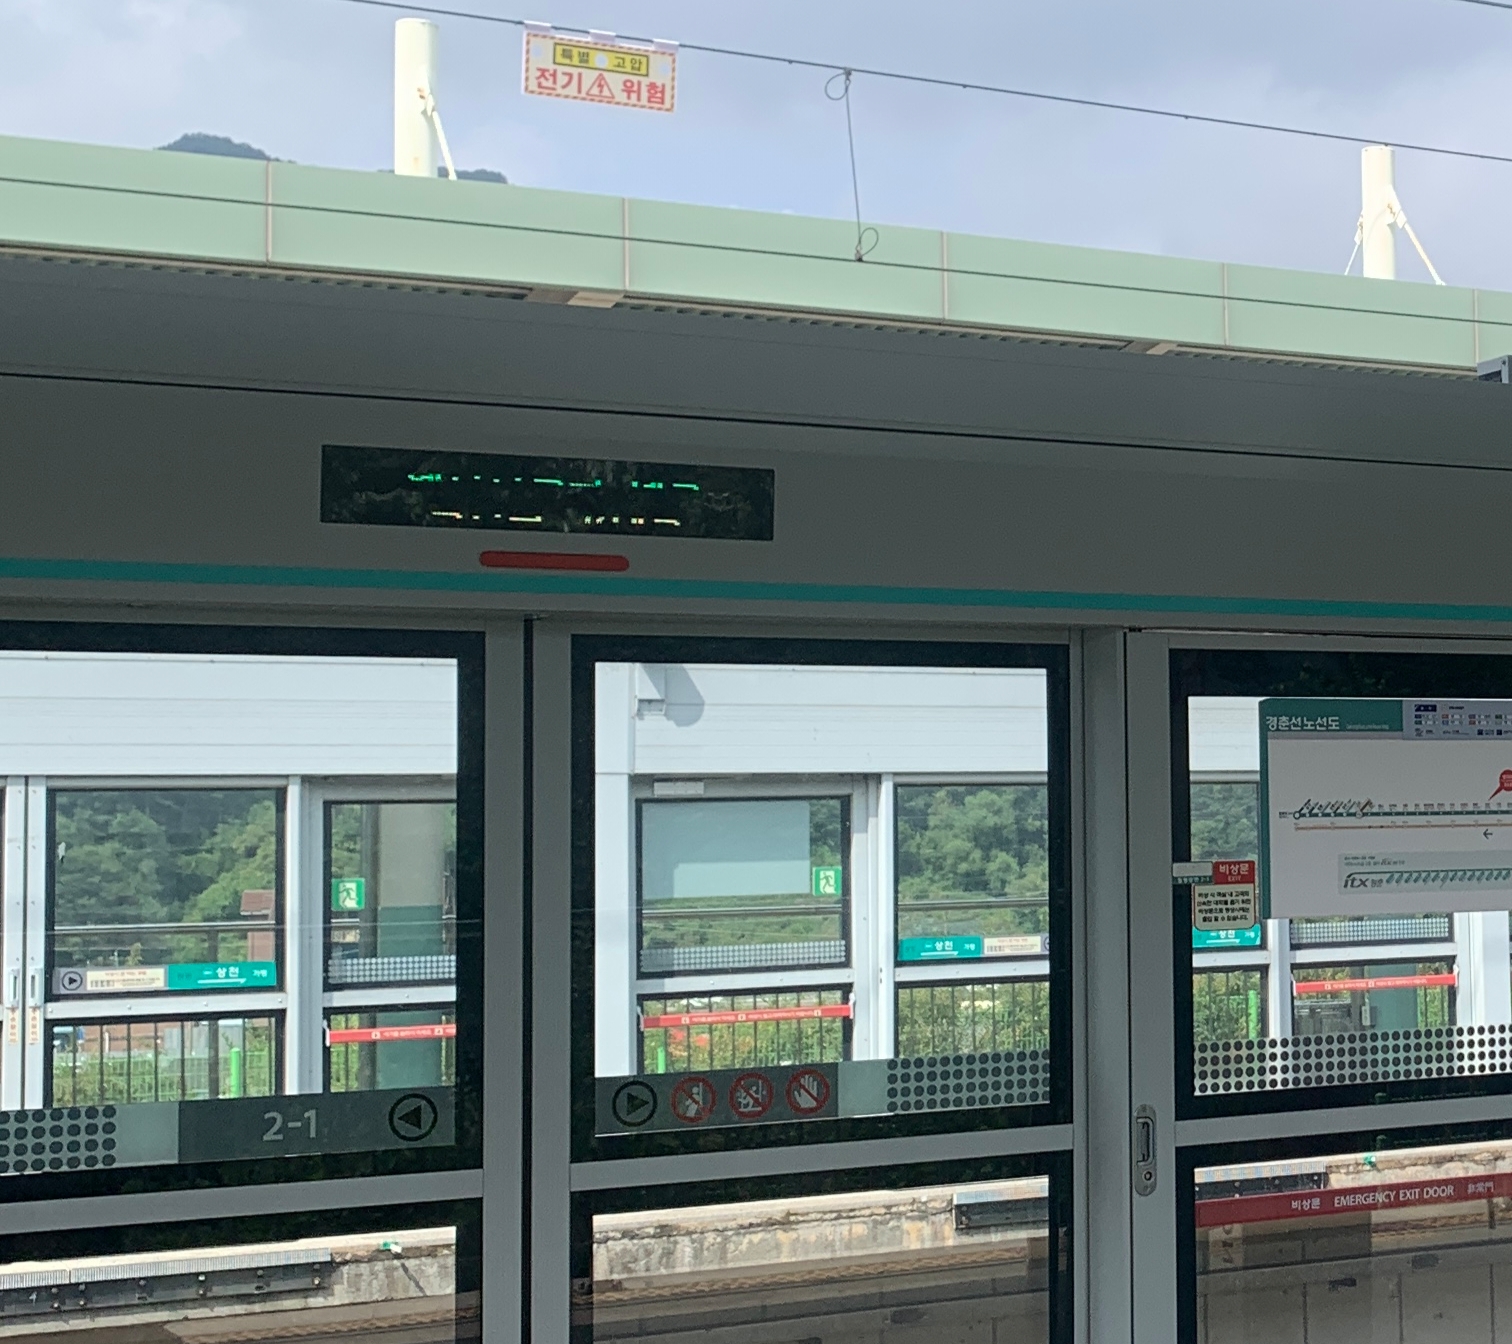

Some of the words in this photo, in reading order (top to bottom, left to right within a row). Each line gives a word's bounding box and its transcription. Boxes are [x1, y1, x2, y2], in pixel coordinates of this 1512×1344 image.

[560, 47, 590, 64] 특별
[613, 56, 643, 72] 고압
[535, 67, 583, 94] 전기
[621, 78, 666, 106] 위험
[1219, 863, 1249, 875] 비상문
[215, 966, 240, 978] 상천
[262, 1109, 318, 1143] 2-1
[1291, 1197, 1321, 1211] 비상문
[1334, 1191, 1396, 1207] EMERGENCY
[1400, 1188, 1421, 1201] EXIT
[1423, 1185, 1455, 1199] DOOR
